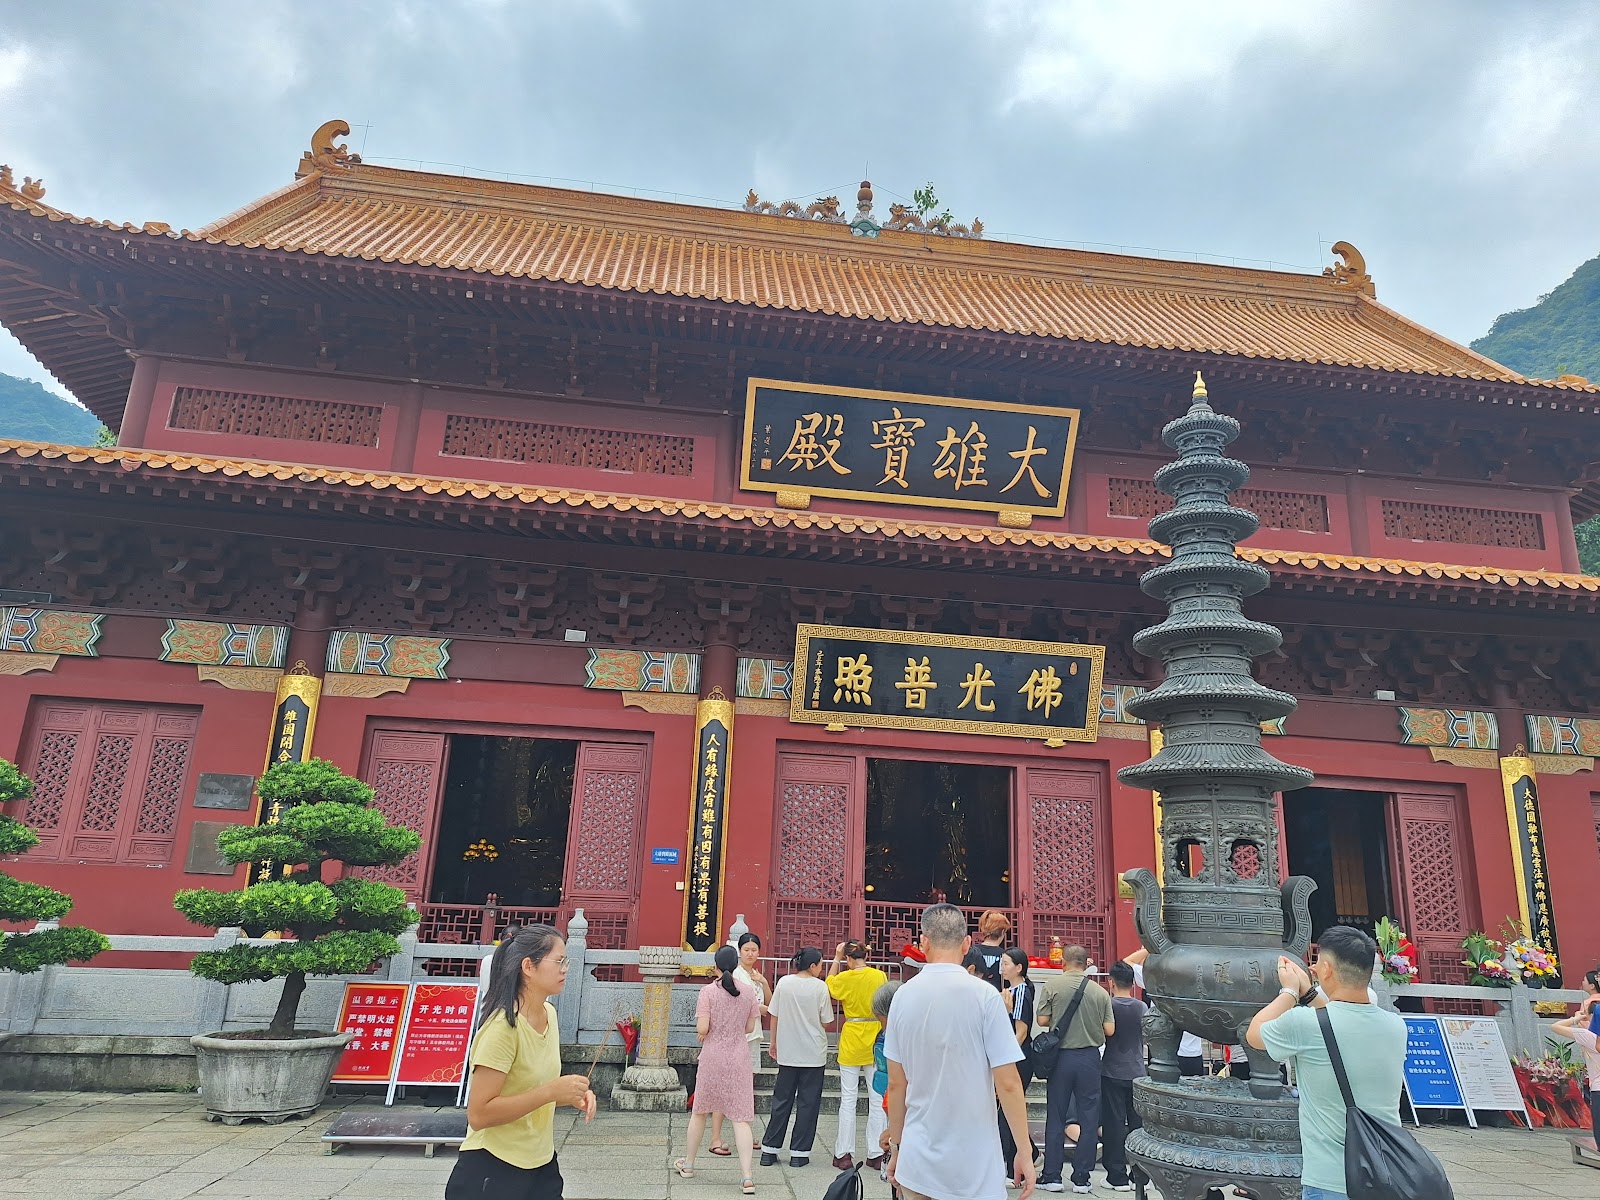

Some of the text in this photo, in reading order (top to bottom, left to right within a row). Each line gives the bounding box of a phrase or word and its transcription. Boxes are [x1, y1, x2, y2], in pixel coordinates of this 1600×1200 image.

[776, 407, 1052, 498] 大雄寶殿
[832, 653, 1064, 719] 佛光普照
[352, 995, 398, 1005] 温馨提示
[419, 1004, 468, 1015] 开光时间
[347, 1014, 395, 1025] 严禁明火进
